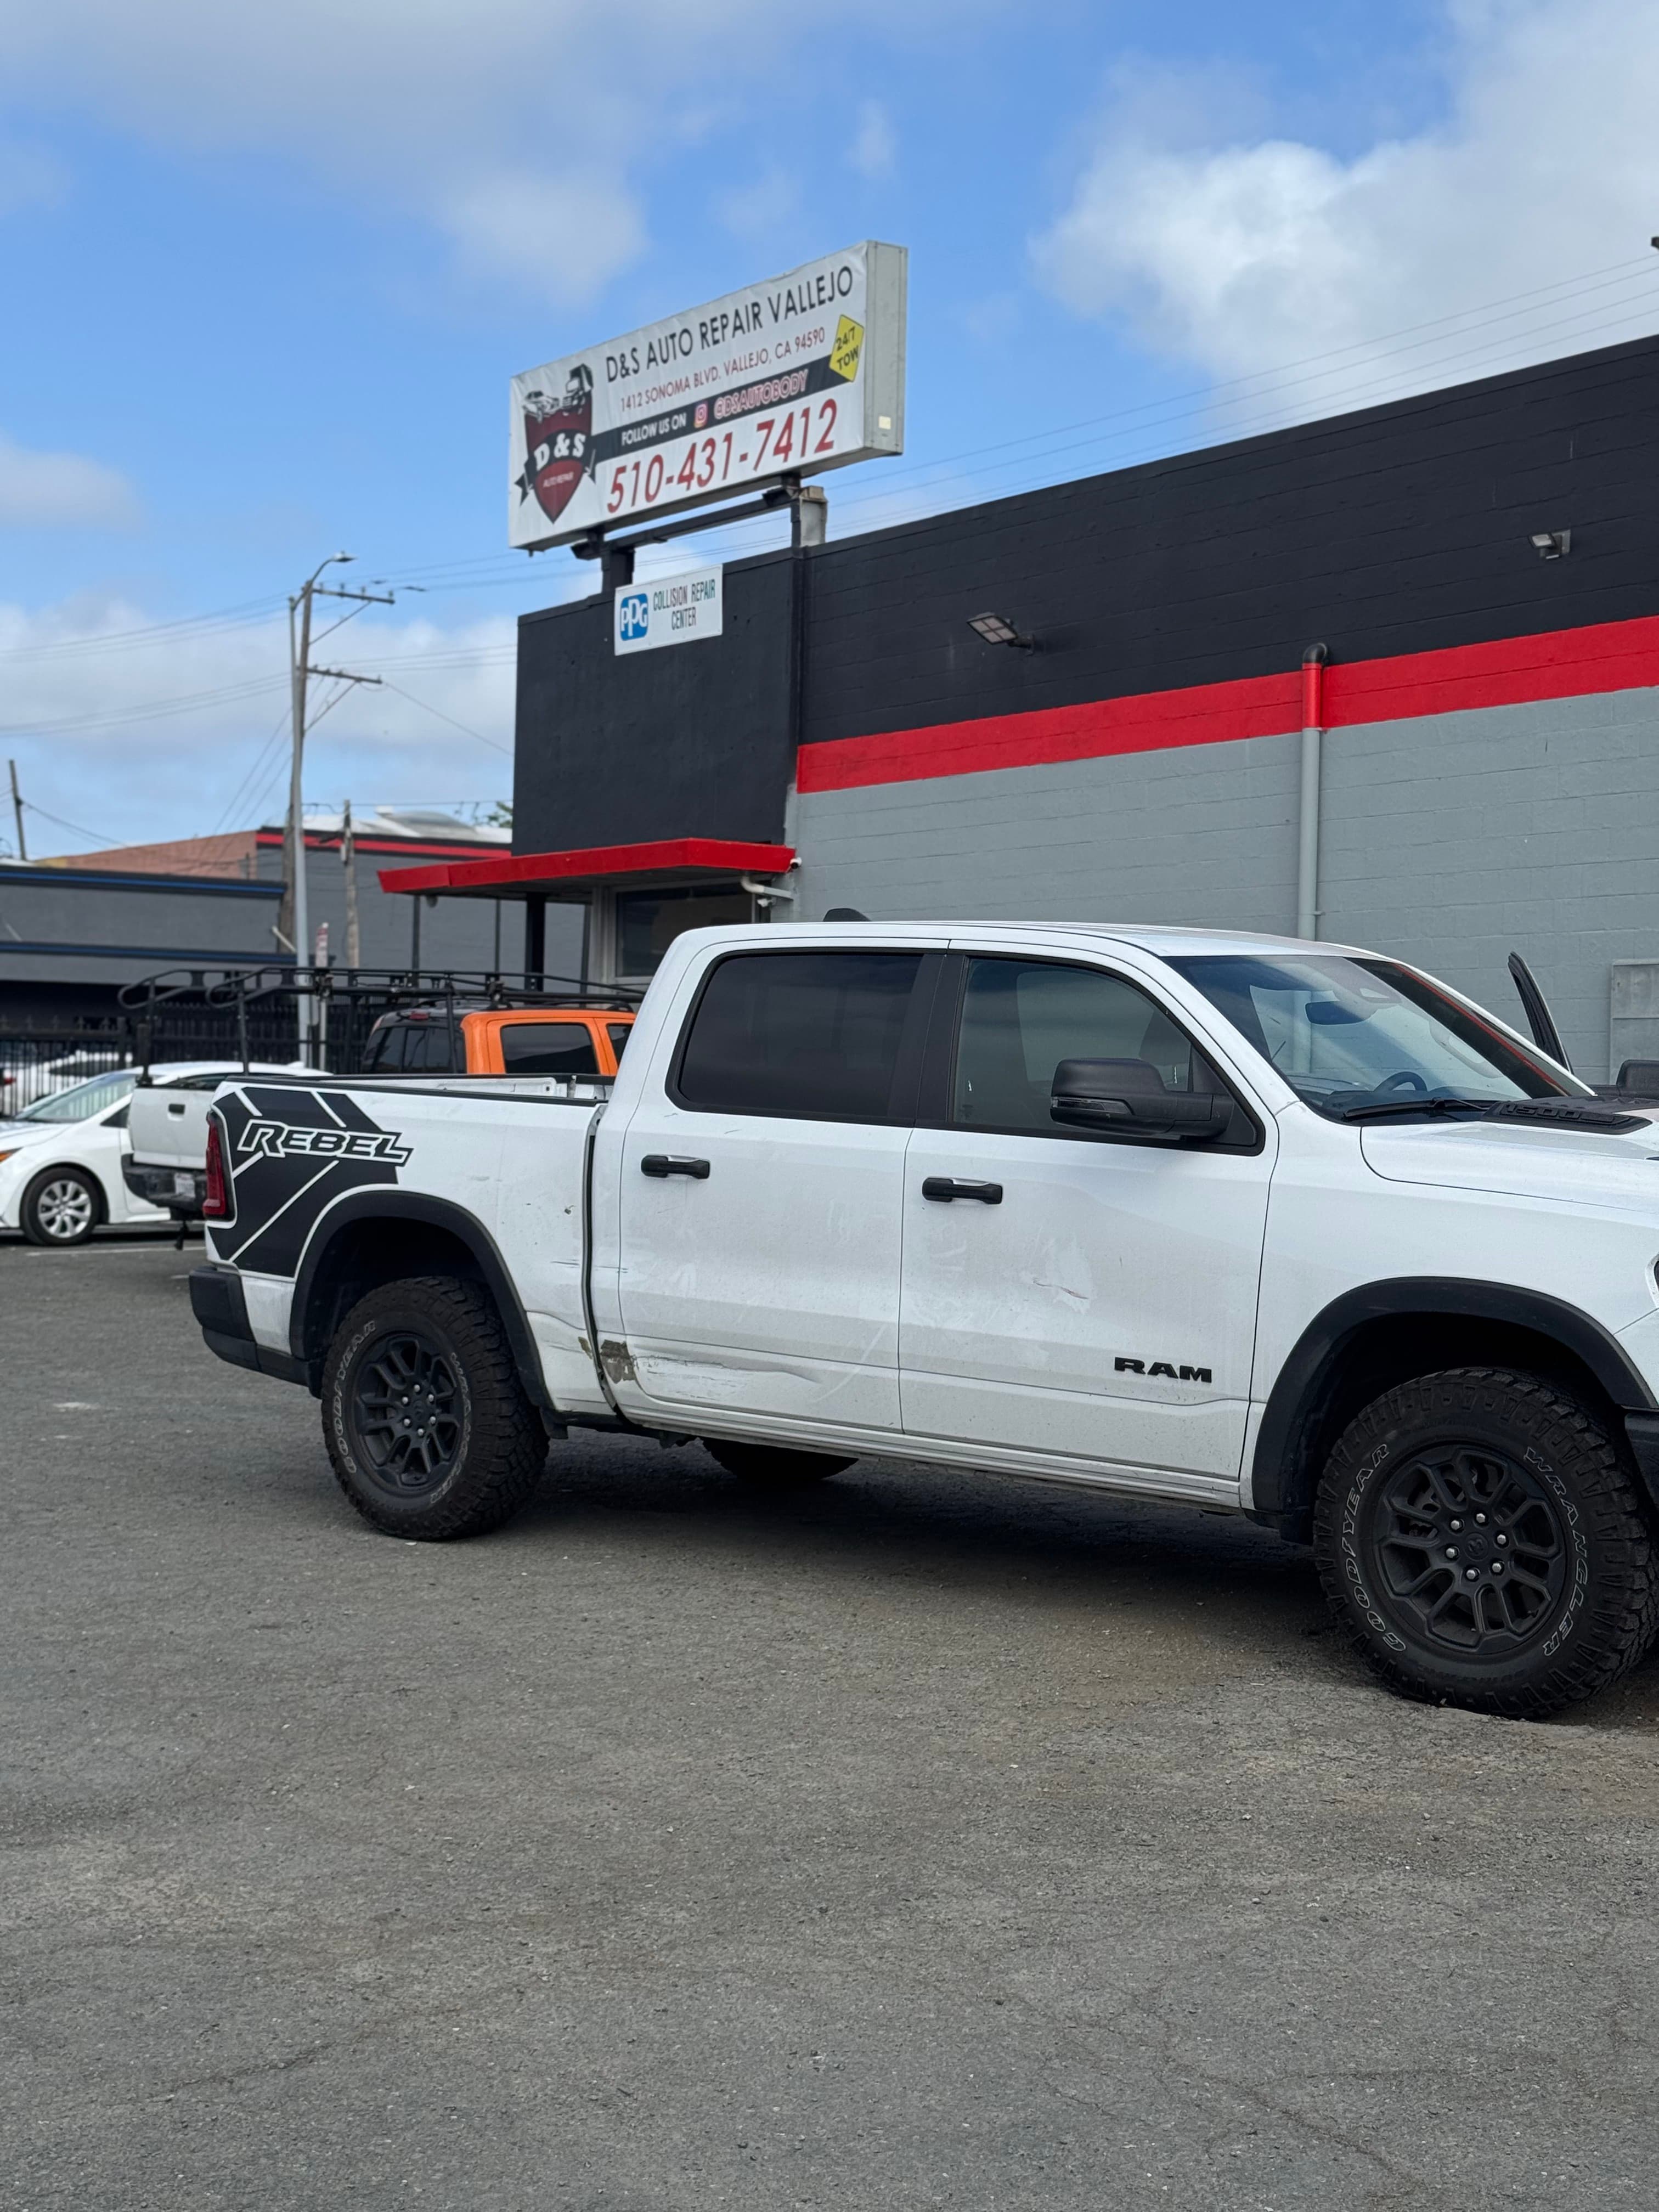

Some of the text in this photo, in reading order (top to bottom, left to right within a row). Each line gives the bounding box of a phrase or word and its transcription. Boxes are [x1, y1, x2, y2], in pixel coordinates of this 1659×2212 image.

[606, 266, 853, 382] D&S AUTO REPAIR VALLEJO
[836, 326, 856, 351] 24/7
[621, 326, 825, 412] 1412 SONOMA BLVD. VALLEJO, CA 94590
[836, 345, 860, 370] TOW
[621, 368, 809, 446] FOLLOW US ON @DSAUTOBODY
[606, 398, 838, 514] 510-431-7412
[653, 579, 715, 612] COLLISION REPAIR
[620, 598, 648, 637] PPG
[671, 606, 697, 631] CENTER
[1505, 1103, 1581, 1120] 1500
[237, 1119, 413, 1165] REBEL
[1114, 1356, 1212, 1384] RAM
[1341, 1444, 1406, 1652] GOODYEAR
[1523, 1446, 1589, 1657] WRANGLER
